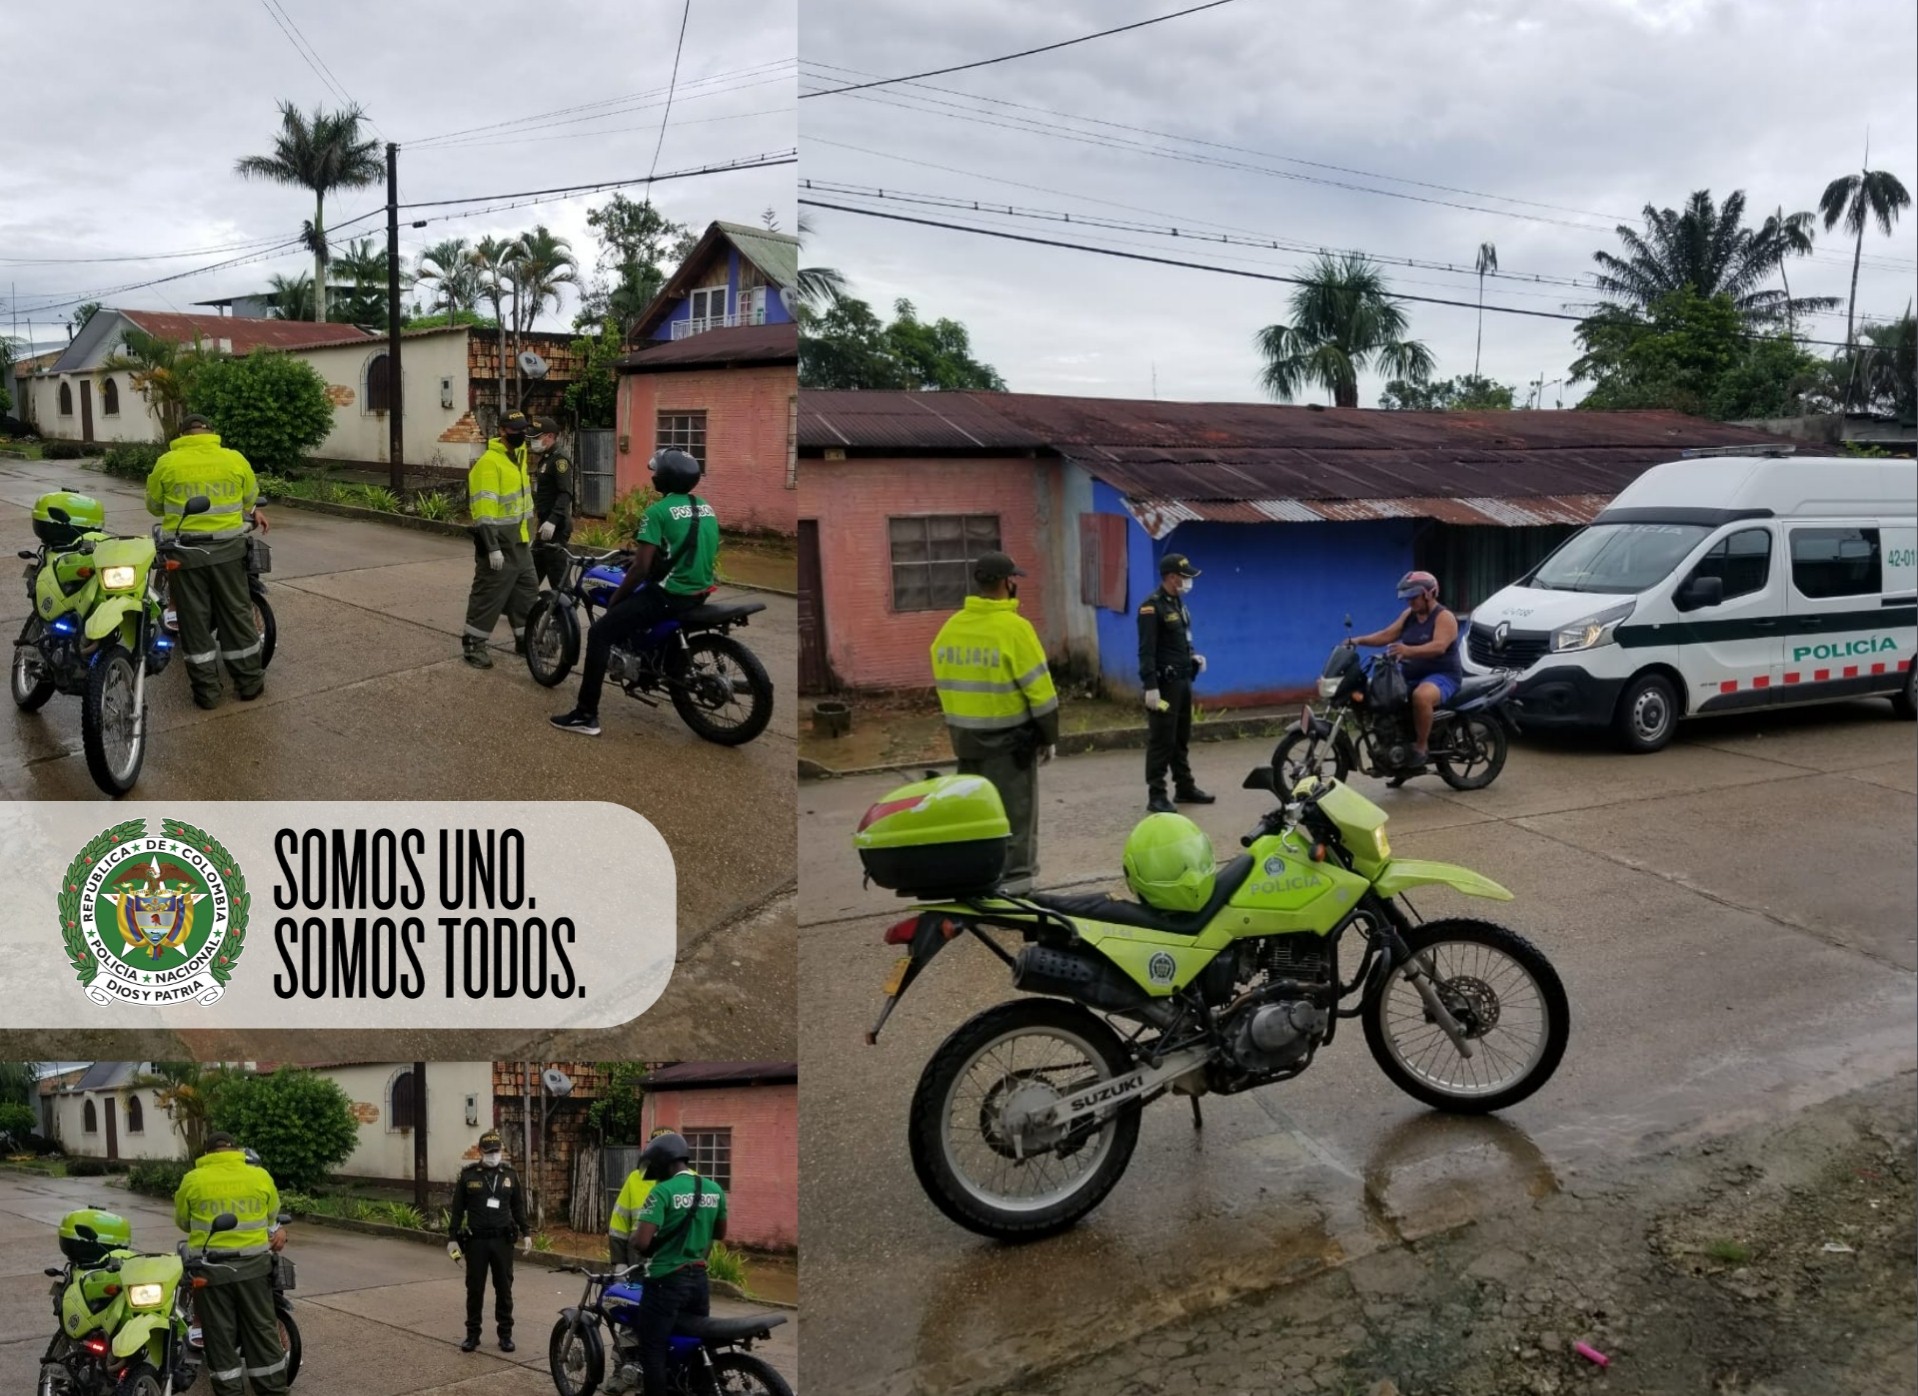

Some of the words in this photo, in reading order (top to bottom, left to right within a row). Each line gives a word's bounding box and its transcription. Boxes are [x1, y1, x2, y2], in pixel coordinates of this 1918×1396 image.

[937, 647, 1000, 668] POLICIA
[1793, 635, 1898, 662] POLICÍA
[1251, 876, 1322, 894] POLICIA
[1070, 1075, 1143, 1111] SUZUKI
